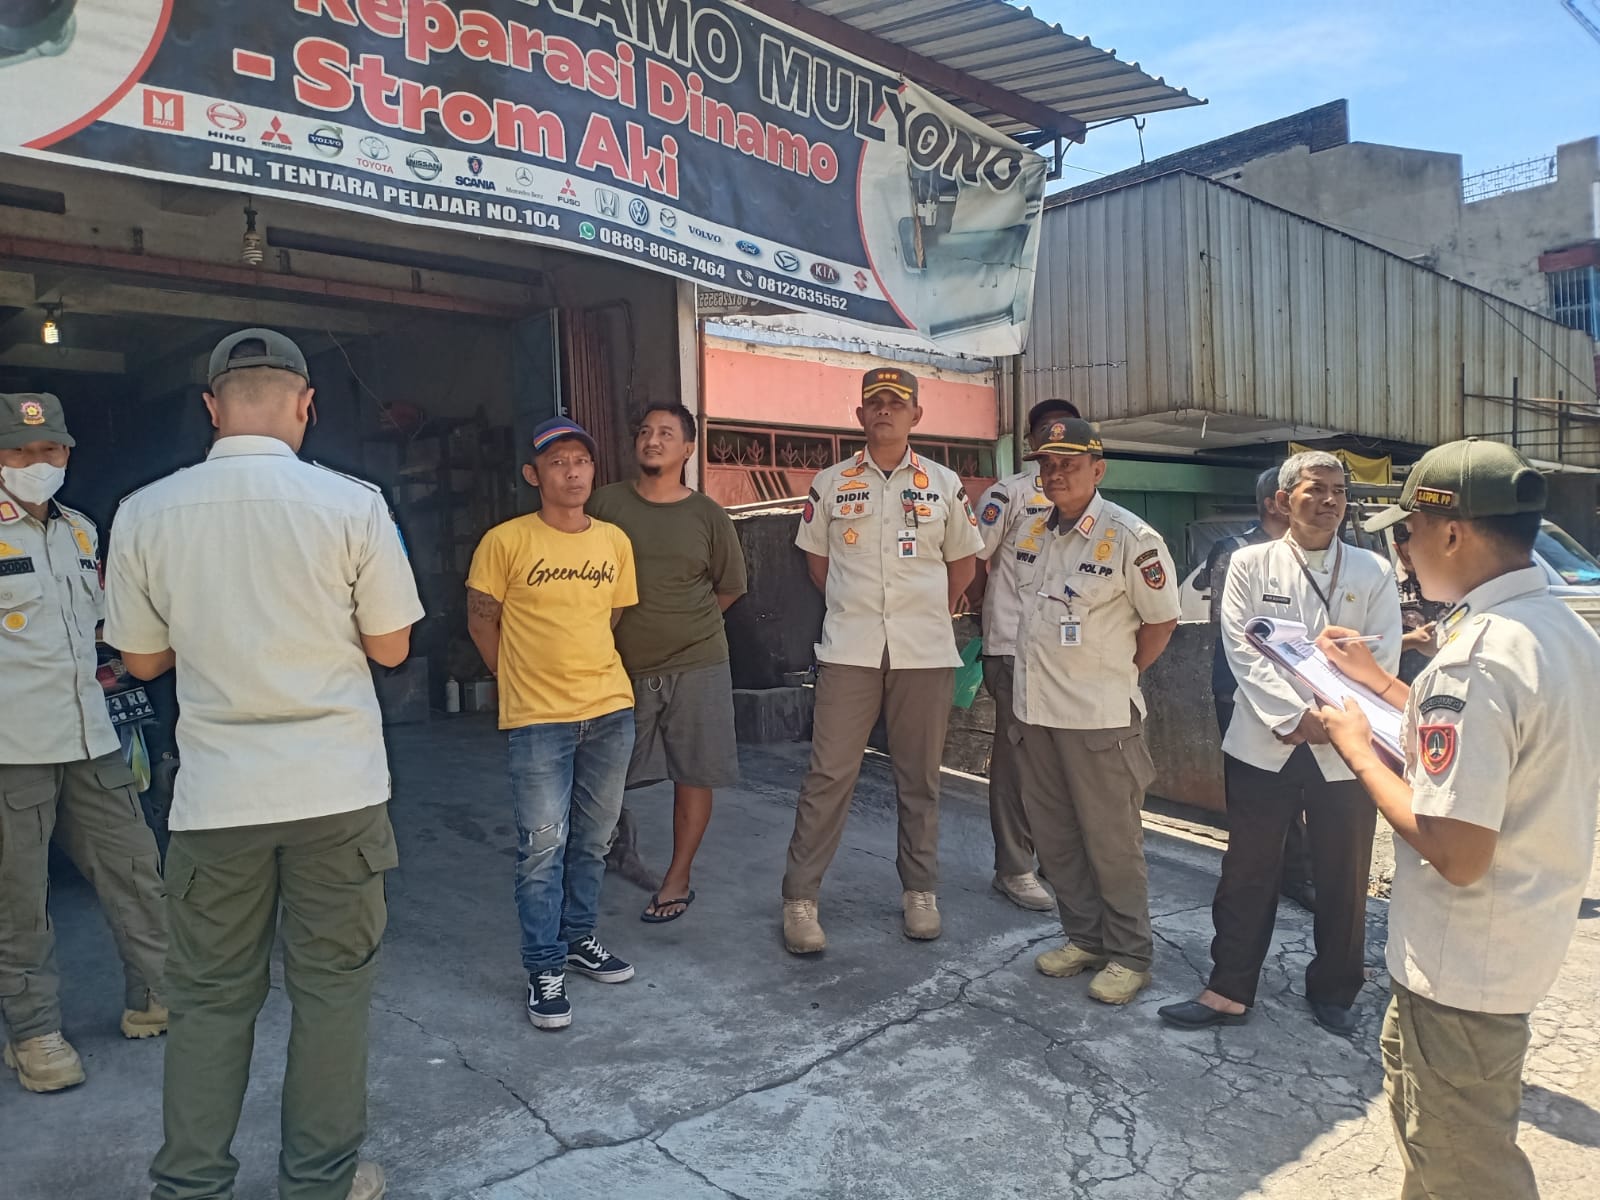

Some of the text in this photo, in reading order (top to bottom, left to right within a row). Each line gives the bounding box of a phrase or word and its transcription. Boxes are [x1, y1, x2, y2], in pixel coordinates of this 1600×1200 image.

[294, 37, 567, 162] Strom
[576, 113, 680, 200] Aki
[759, 33, 1023, 192] MULYONO
[646, 57, 839, 185] Dinamo
[208, 130, 246, 143] HINO
[310, 135, 342, 148] VOLVO
[356, 157, 394, 175] TOYOTA
[408, 158, 440, 170] NISSAN
[209, 151, 561, 231] JLN. TENTARA PELAJAR NO.104
[456, 176, 496, 191] SCANIA
[557, 195, 580, 206] FUSO
[688, 225, 721, 242] VOLVO
[599, 226, 726, 280] 0889-8058-7464
[815, 265, 835, 280] KIA
[757, 275, 848, 312] 08122635552
[836, 491, 870, 503] DIDIK
[927, 493, 940, 502] PP
[527, 558, 615, 588] Greenlight
[1079, 563, 1113, 577] POL PP
